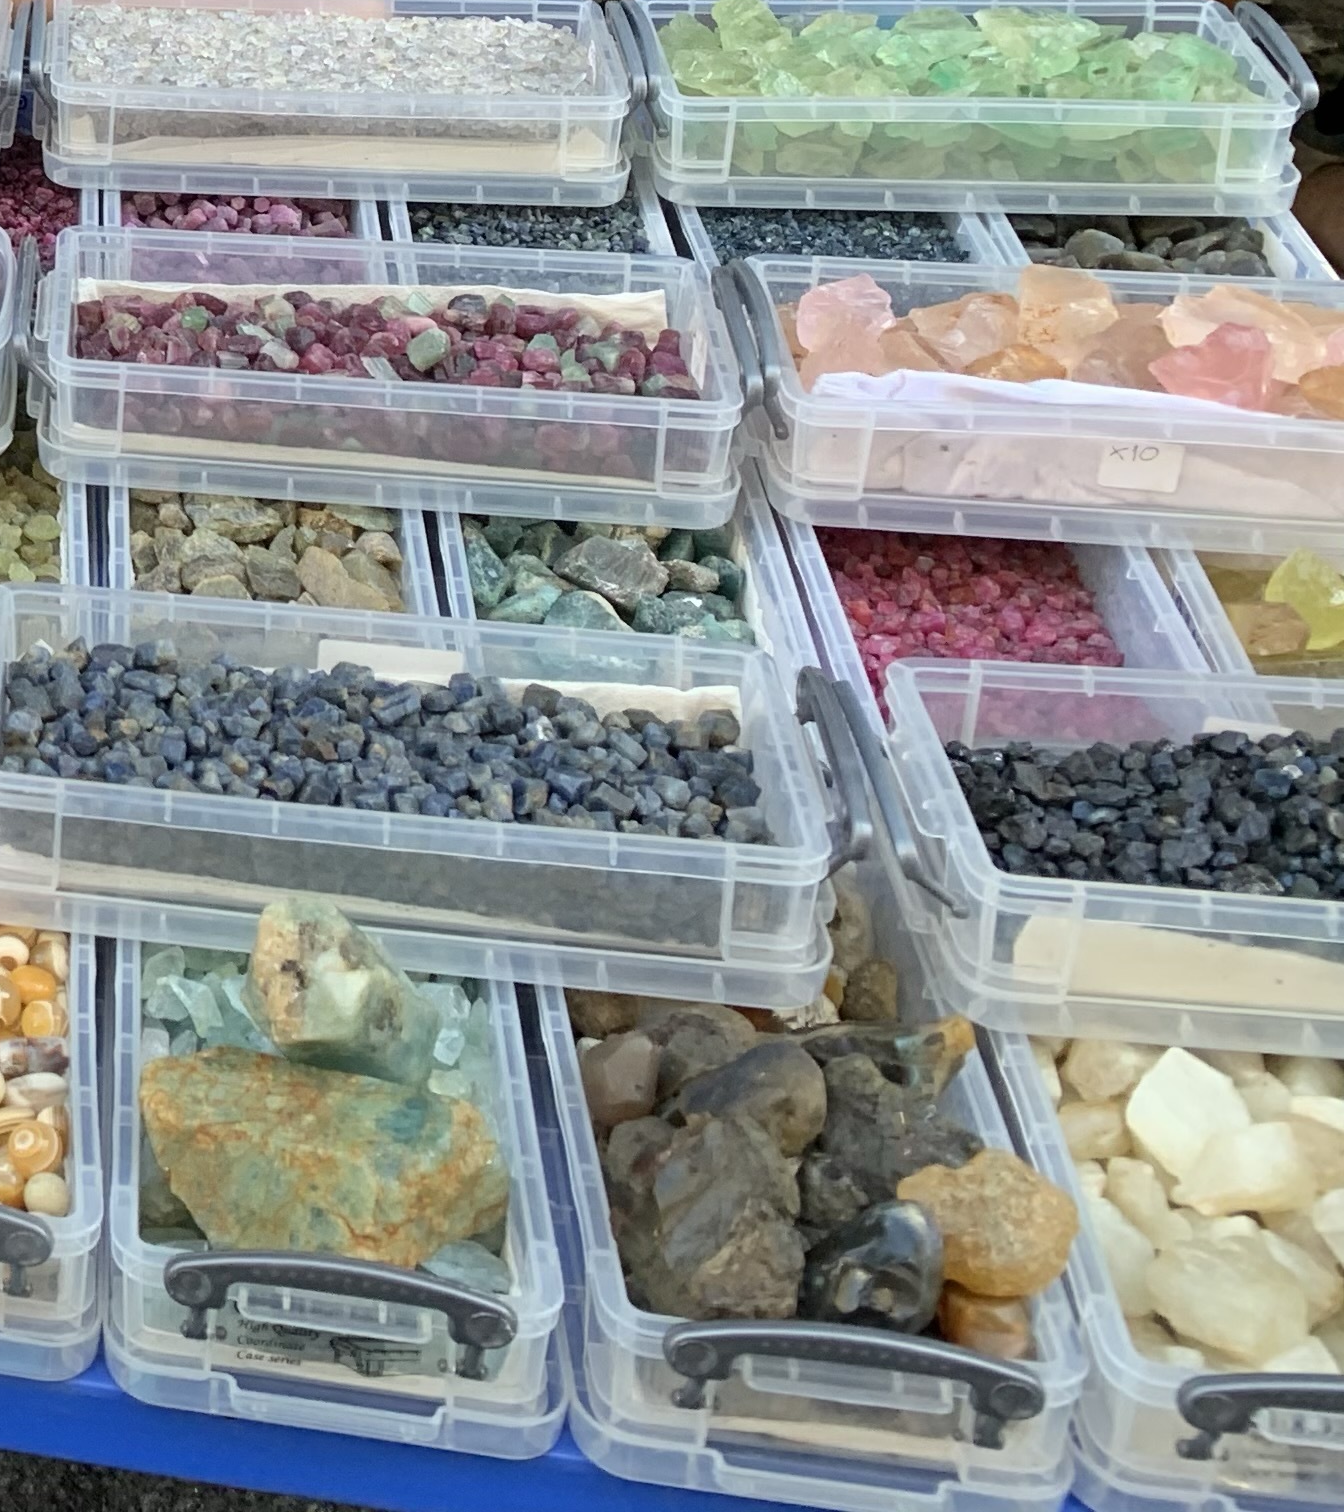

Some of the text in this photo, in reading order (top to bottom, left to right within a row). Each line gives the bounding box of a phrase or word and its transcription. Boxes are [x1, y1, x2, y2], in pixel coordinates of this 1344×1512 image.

[236, 1335, 306, 1352] Coordinate
[236, 1350, 301, 1367] Case series
